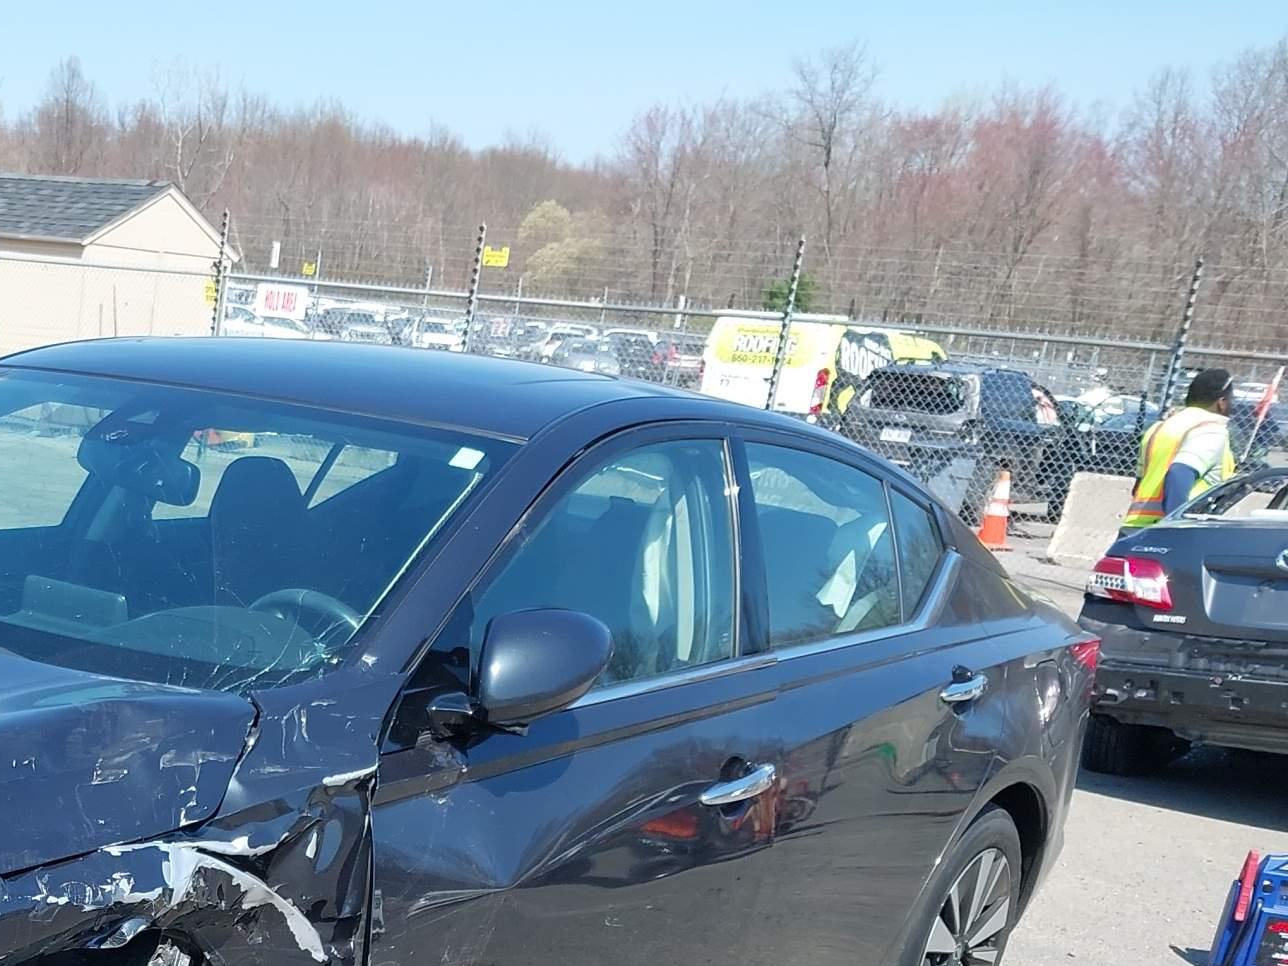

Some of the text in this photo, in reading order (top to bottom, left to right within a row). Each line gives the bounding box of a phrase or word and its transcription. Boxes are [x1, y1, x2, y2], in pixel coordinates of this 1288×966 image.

[264, 288, 298, 313] HOLD AREA
[734, 335, 799, 355] ROOFIG
